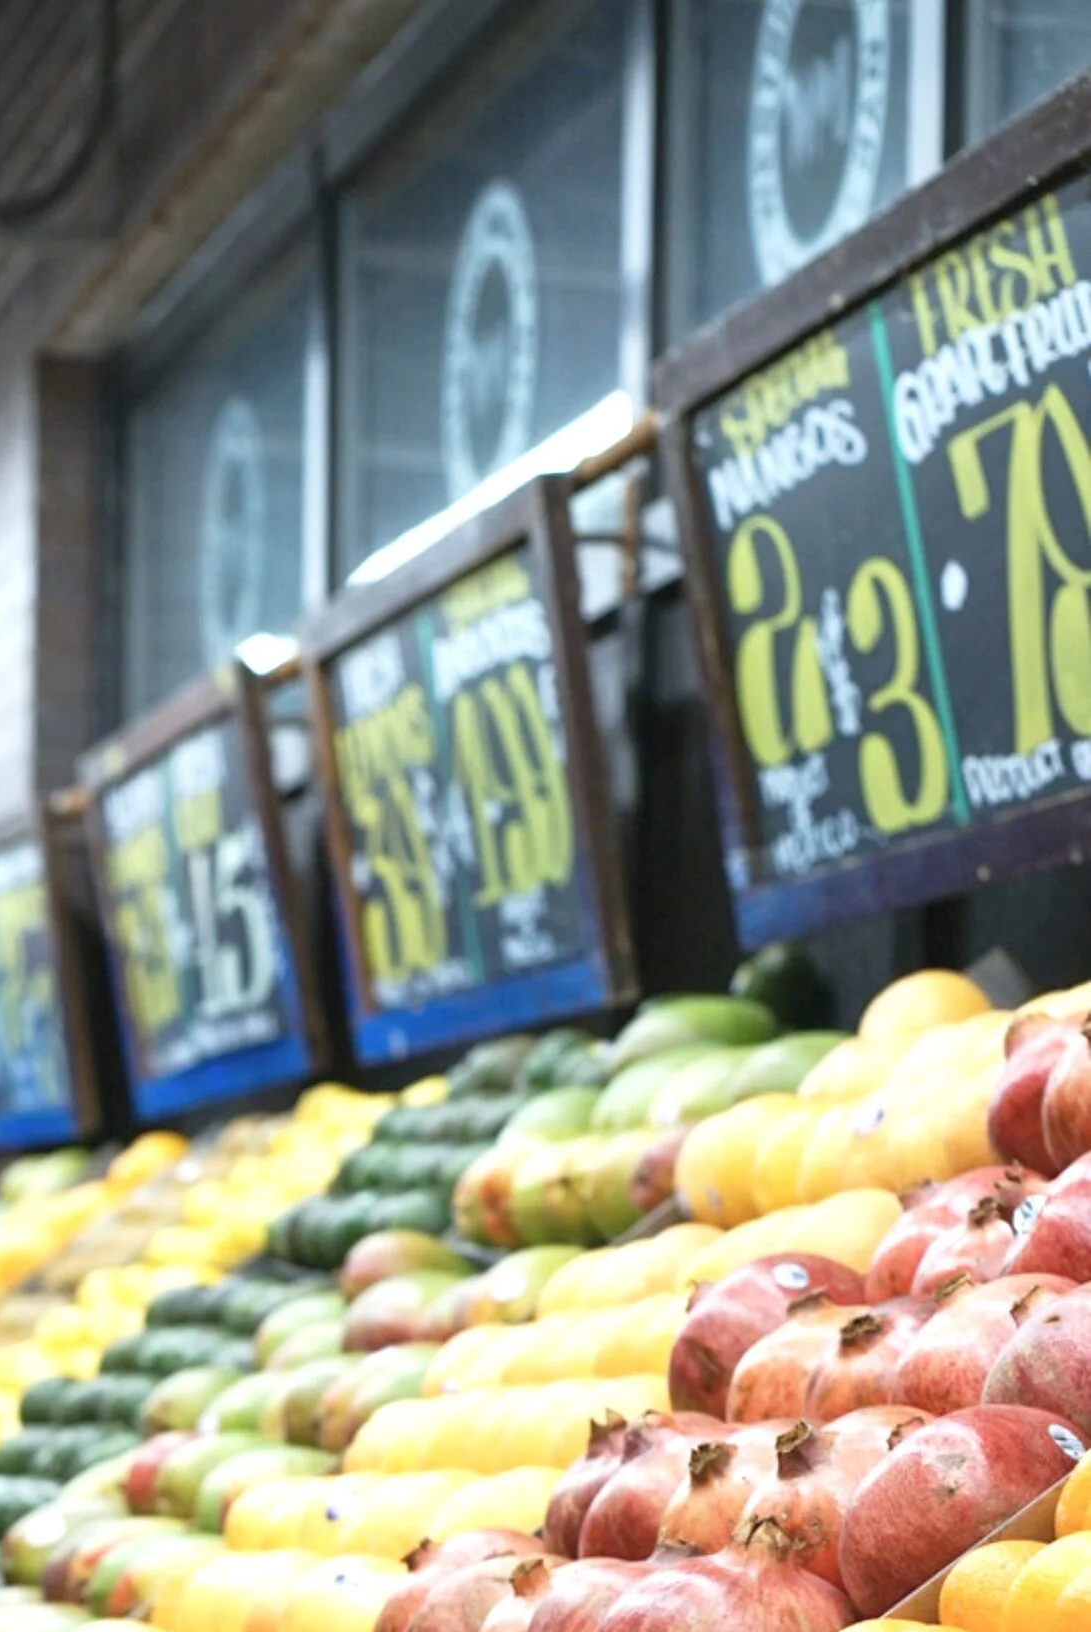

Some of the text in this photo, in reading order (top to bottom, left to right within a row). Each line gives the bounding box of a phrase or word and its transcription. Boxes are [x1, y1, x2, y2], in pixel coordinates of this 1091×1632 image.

[911, 193, 1075, 358] FRESH
[728, 514, 833, 766] 2
[847, 558, 947, 834] 3
